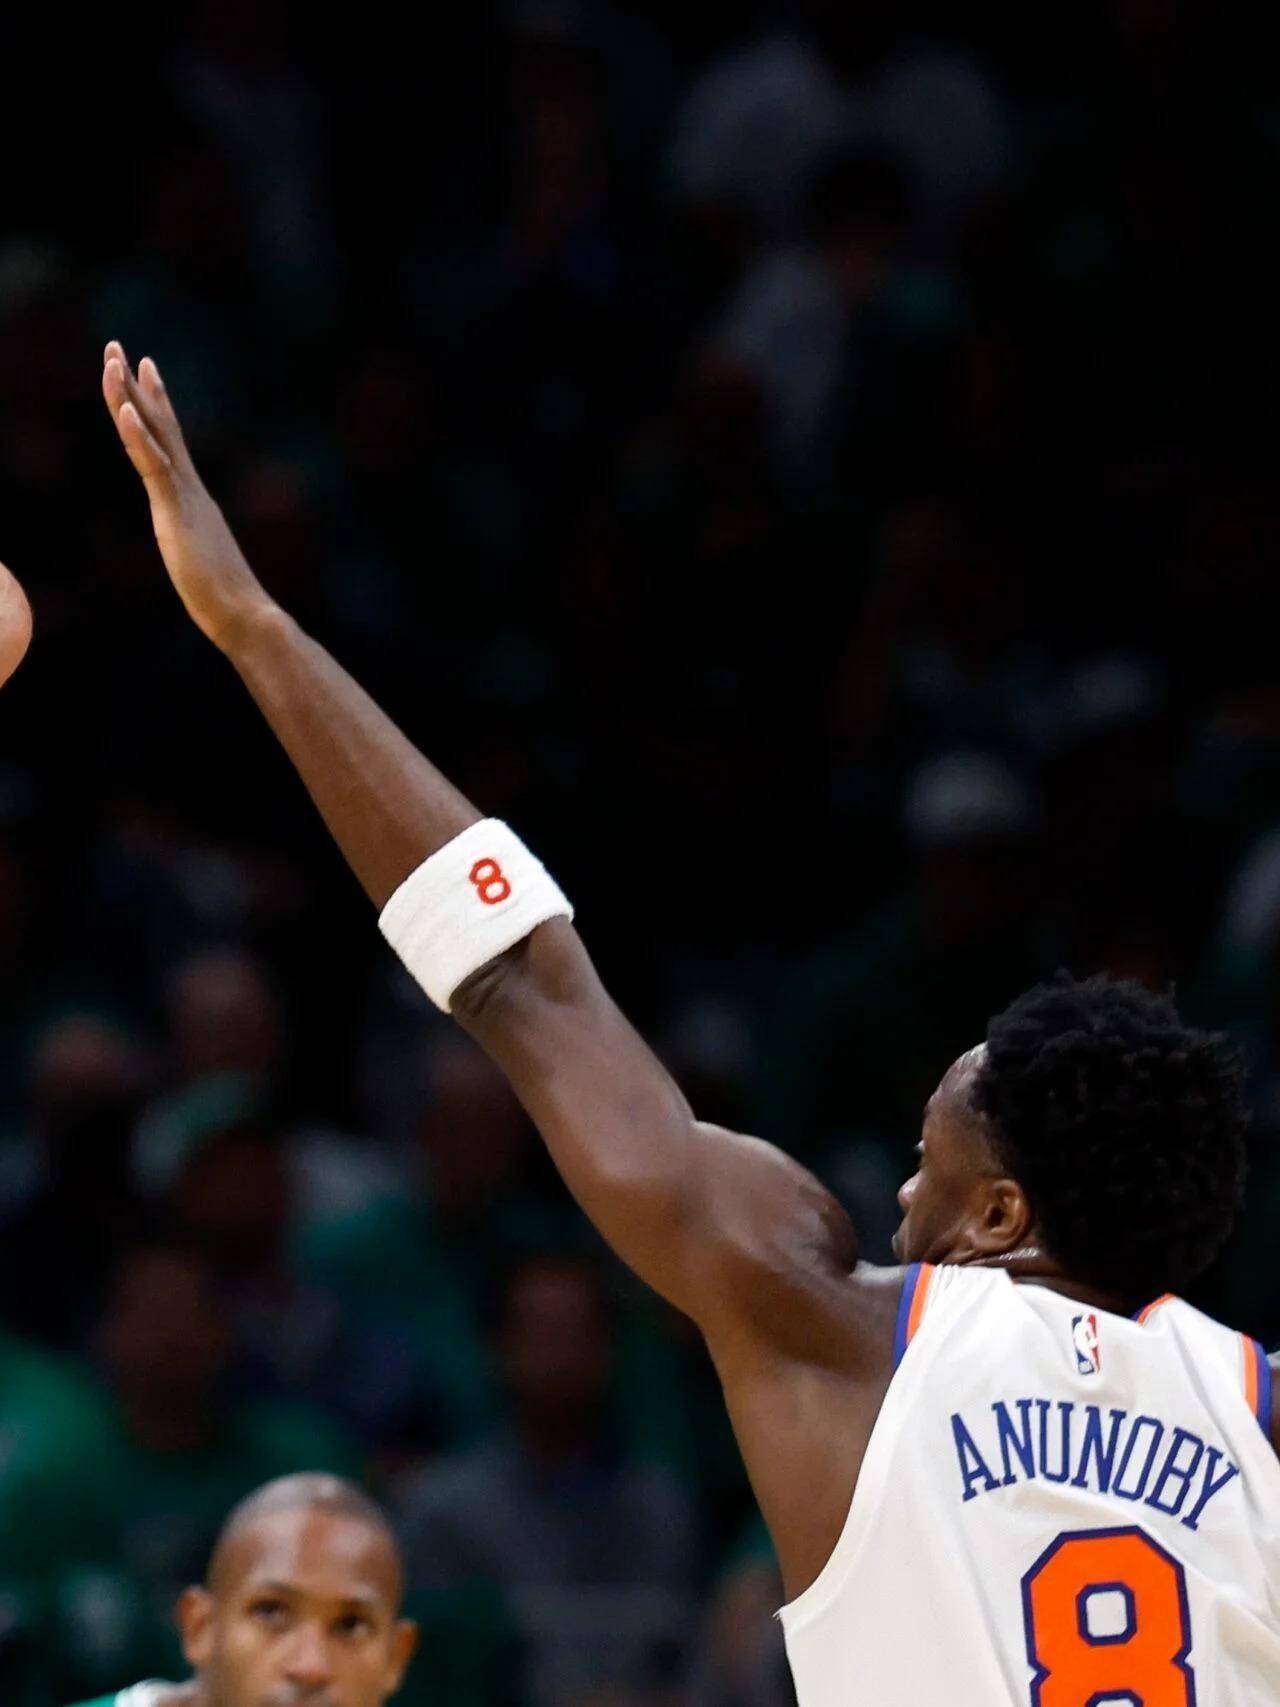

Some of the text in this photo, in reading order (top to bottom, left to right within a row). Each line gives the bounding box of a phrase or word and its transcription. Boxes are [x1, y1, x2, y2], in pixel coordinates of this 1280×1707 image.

[469, 857, 511, 905] 8
[950, 1395, 1240, 1532] ANUNOBY
[1020, 1525, 1197, 1707] 8
